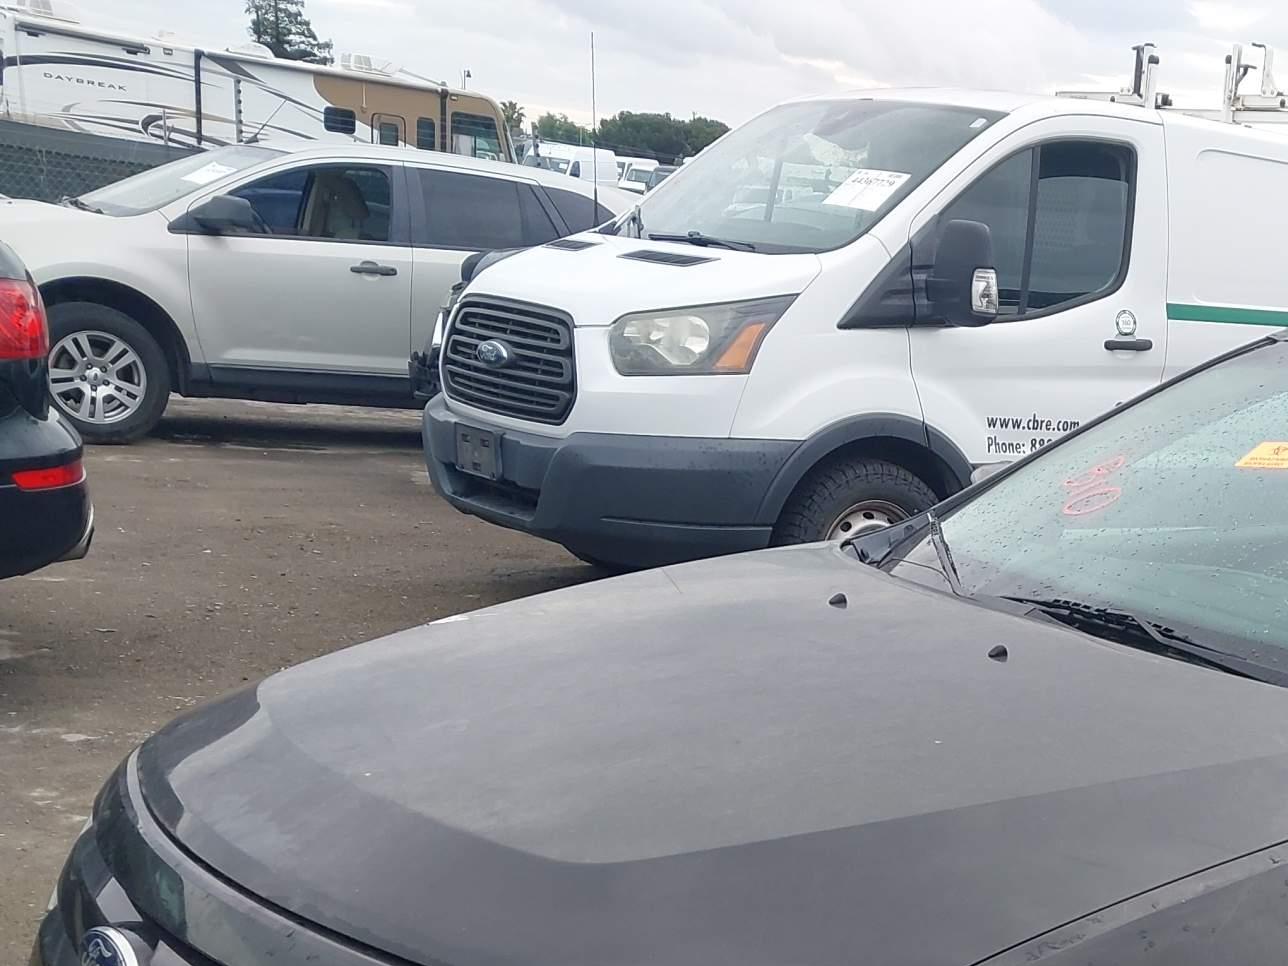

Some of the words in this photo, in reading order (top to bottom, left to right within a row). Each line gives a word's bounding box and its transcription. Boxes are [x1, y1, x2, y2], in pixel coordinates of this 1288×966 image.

[43, 72, 128, 92] DAYBREAK
[986, 413, 1080, 432] www.cbre.com
[987, 436, 1026, 454] Phone:
